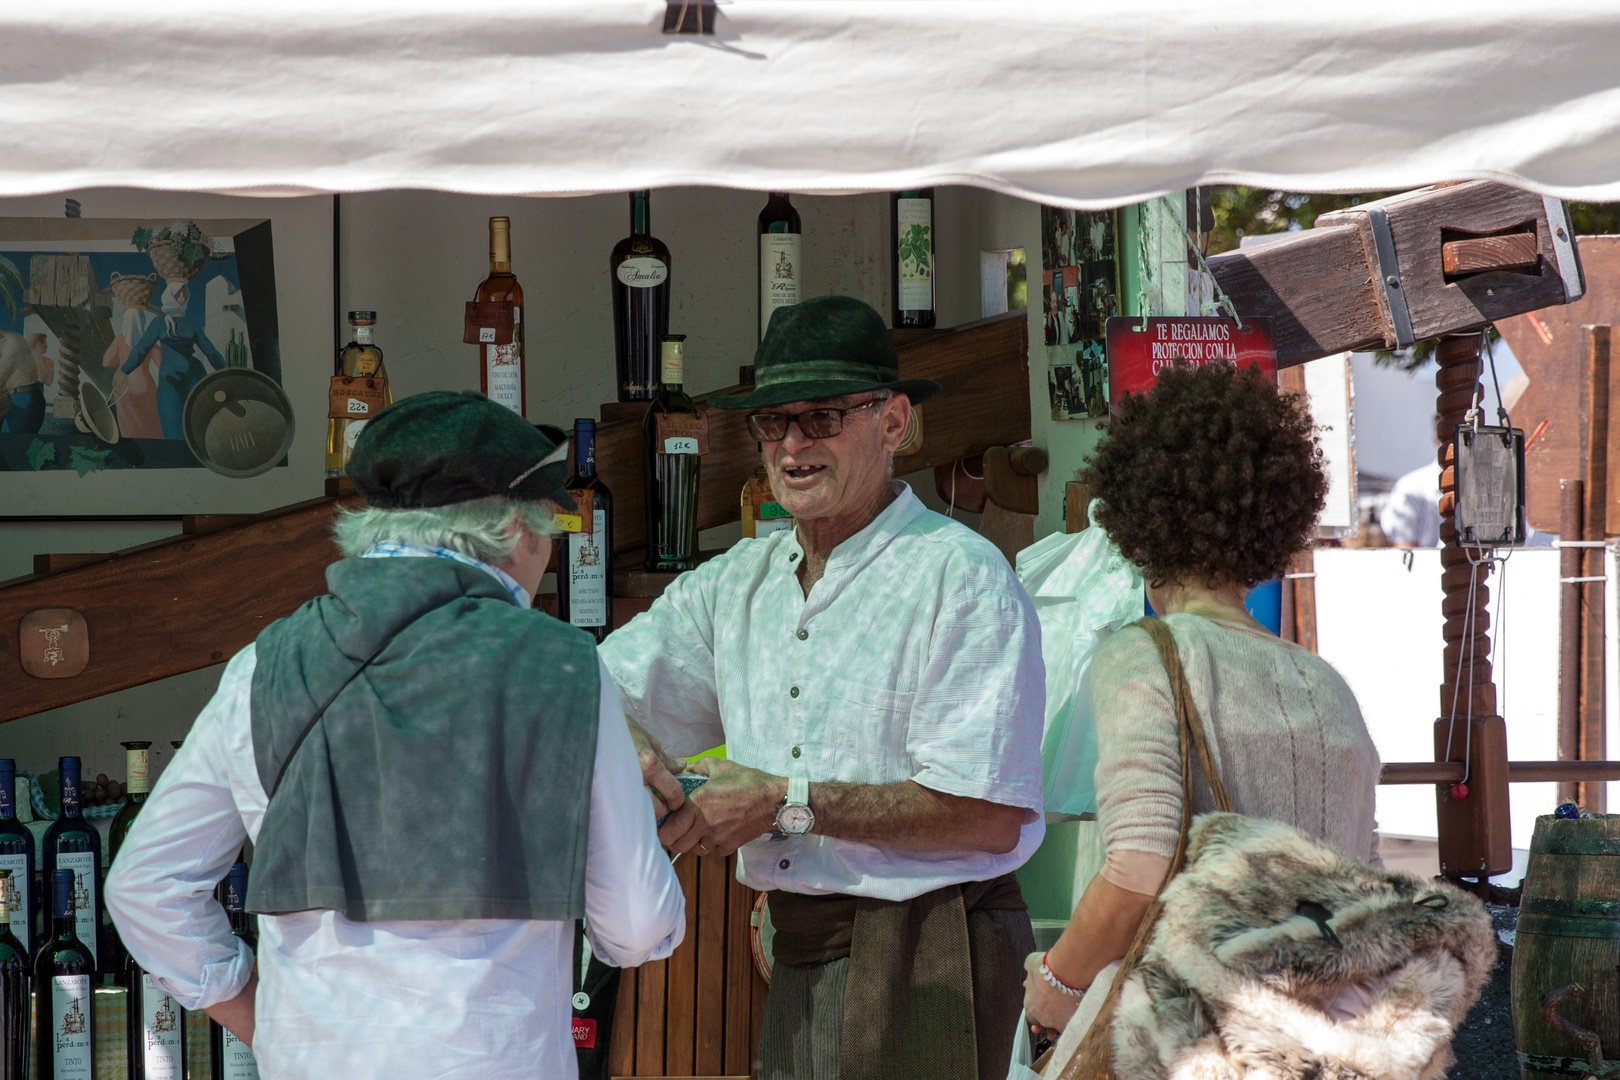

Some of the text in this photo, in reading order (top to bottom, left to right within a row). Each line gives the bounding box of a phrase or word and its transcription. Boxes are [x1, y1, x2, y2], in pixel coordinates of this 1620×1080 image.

[624, 268, 662, 282] Amalia
[1156, 324, 1230, 340] TE REGALAMOS
[1152, 342, 1237, 360] PROTECCION CON LA
